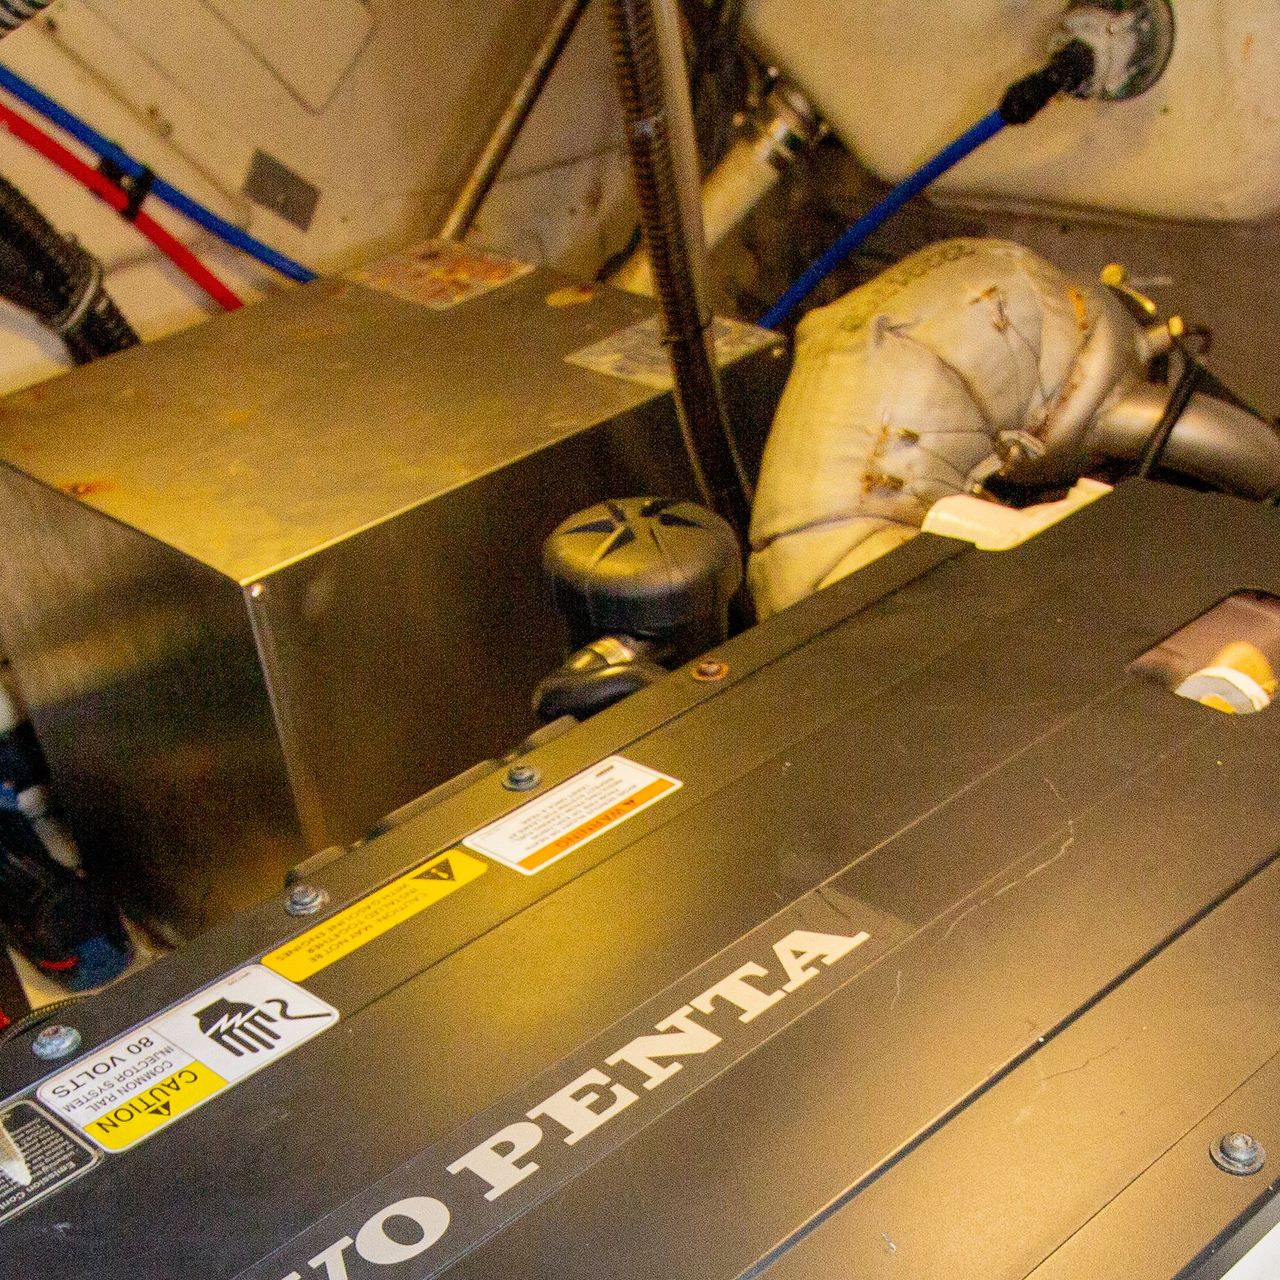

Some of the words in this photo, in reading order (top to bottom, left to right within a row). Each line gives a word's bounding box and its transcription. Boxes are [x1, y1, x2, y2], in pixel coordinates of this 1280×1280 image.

[552, 806, 626, 849] WARNING
[304, 918, 365, 955] TOGETHER
[321, 937, 350, 954] NOT
[347, 923, 374, 939] MAY
[112, 1044, 174, 1083] INJECTOR
[125, 1036, 154, 1055] 80
[49, 1051, 126, 1099] VOLTS
[115, 1059, 174, 1096] COMMON
[446, 929, 871, 1201] PENTA
[61, 1079, 115, 1113] SYSTEM
[84, 1093, 118, 1114] RAIL
[94, 1068, 199, 1134] CAUTION
[23, 1160, 77, 1194] Emission
